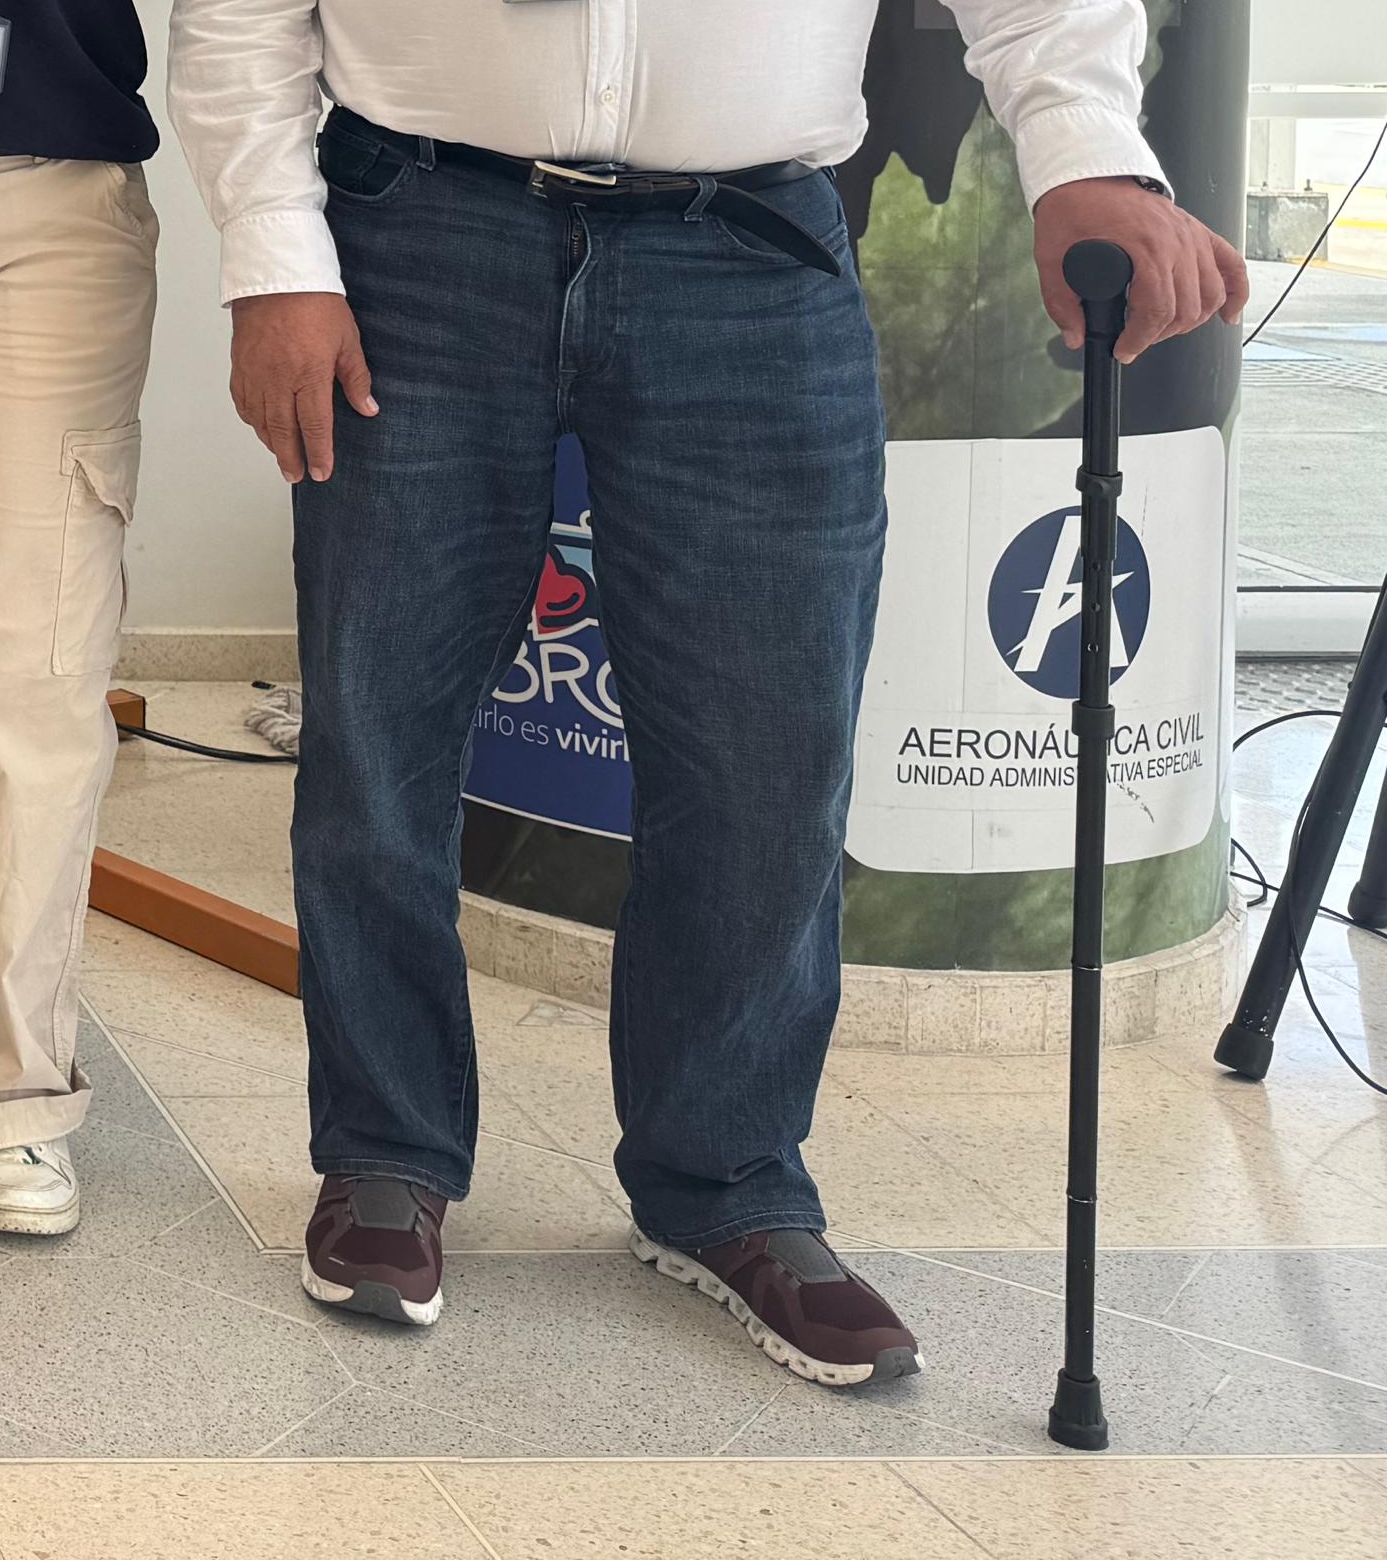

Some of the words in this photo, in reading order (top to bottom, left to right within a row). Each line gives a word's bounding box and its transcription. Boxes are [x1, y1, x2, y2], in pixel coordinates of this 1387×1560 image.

[473, 704, 514, 736] irlo
[521, 721, 550, 746] es
[899, 723, 1150, 761] AERONÁUICA
[1157, 711, 1204, 750] CIVIL
[896, 763, 984, 787] UNIDAD
[989, 762, 1144, 787] ADMINISTIVA
[1146, 748, 1203, 780] ESPECIAL
